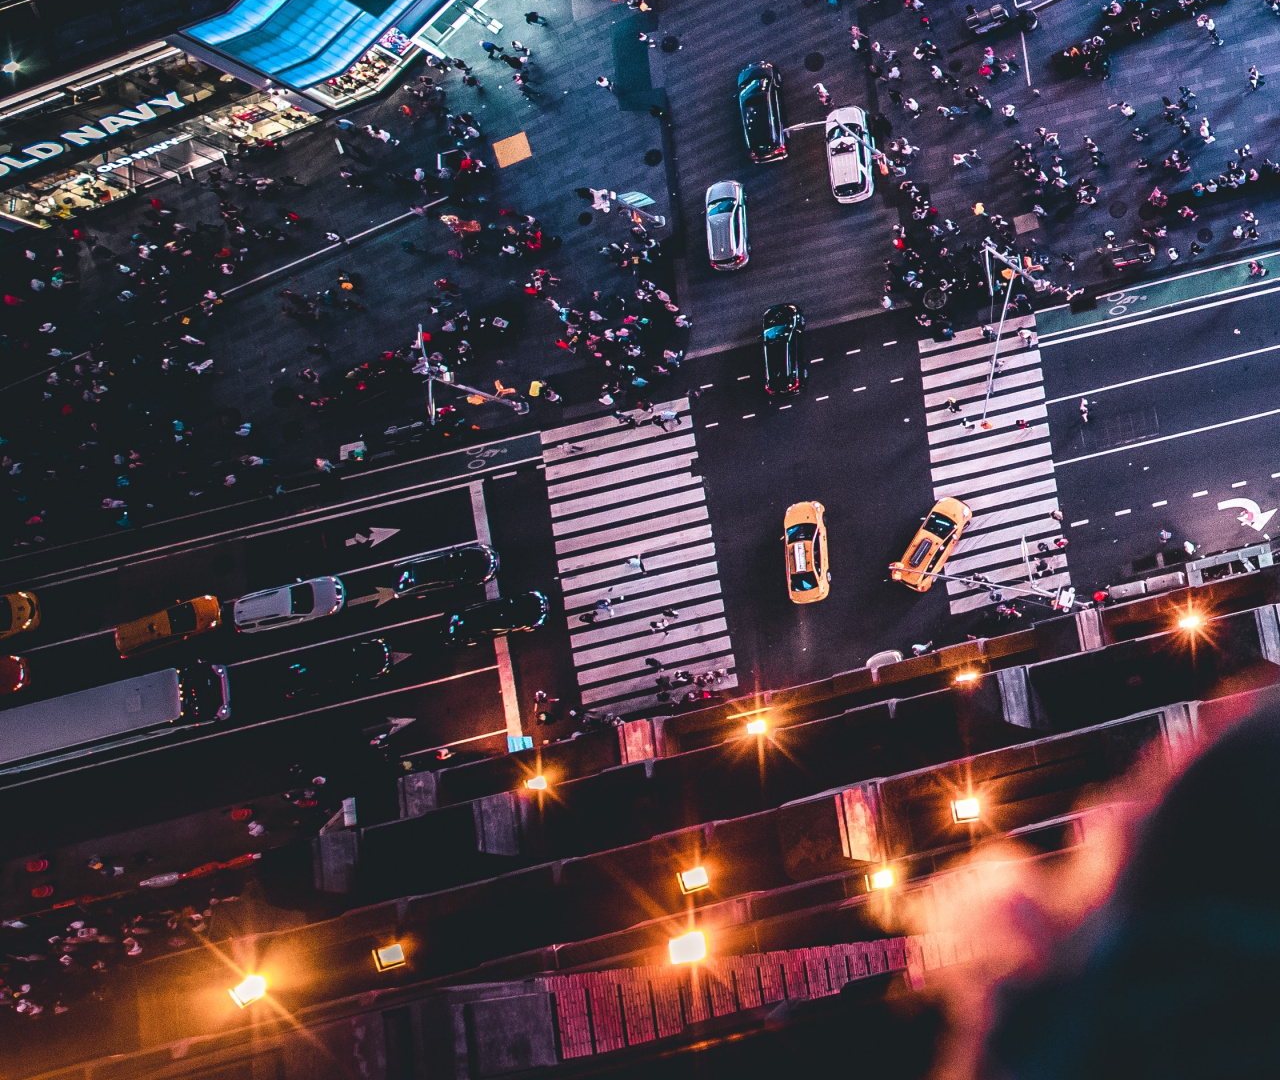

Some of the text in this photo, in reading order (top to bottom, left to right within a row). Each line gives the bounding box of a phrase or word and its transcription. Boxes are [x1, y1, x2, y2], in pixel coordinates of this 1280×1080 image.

[60, 91, 186, 146] NAVY
[96, 137, 179, 173] OLD NAVY
